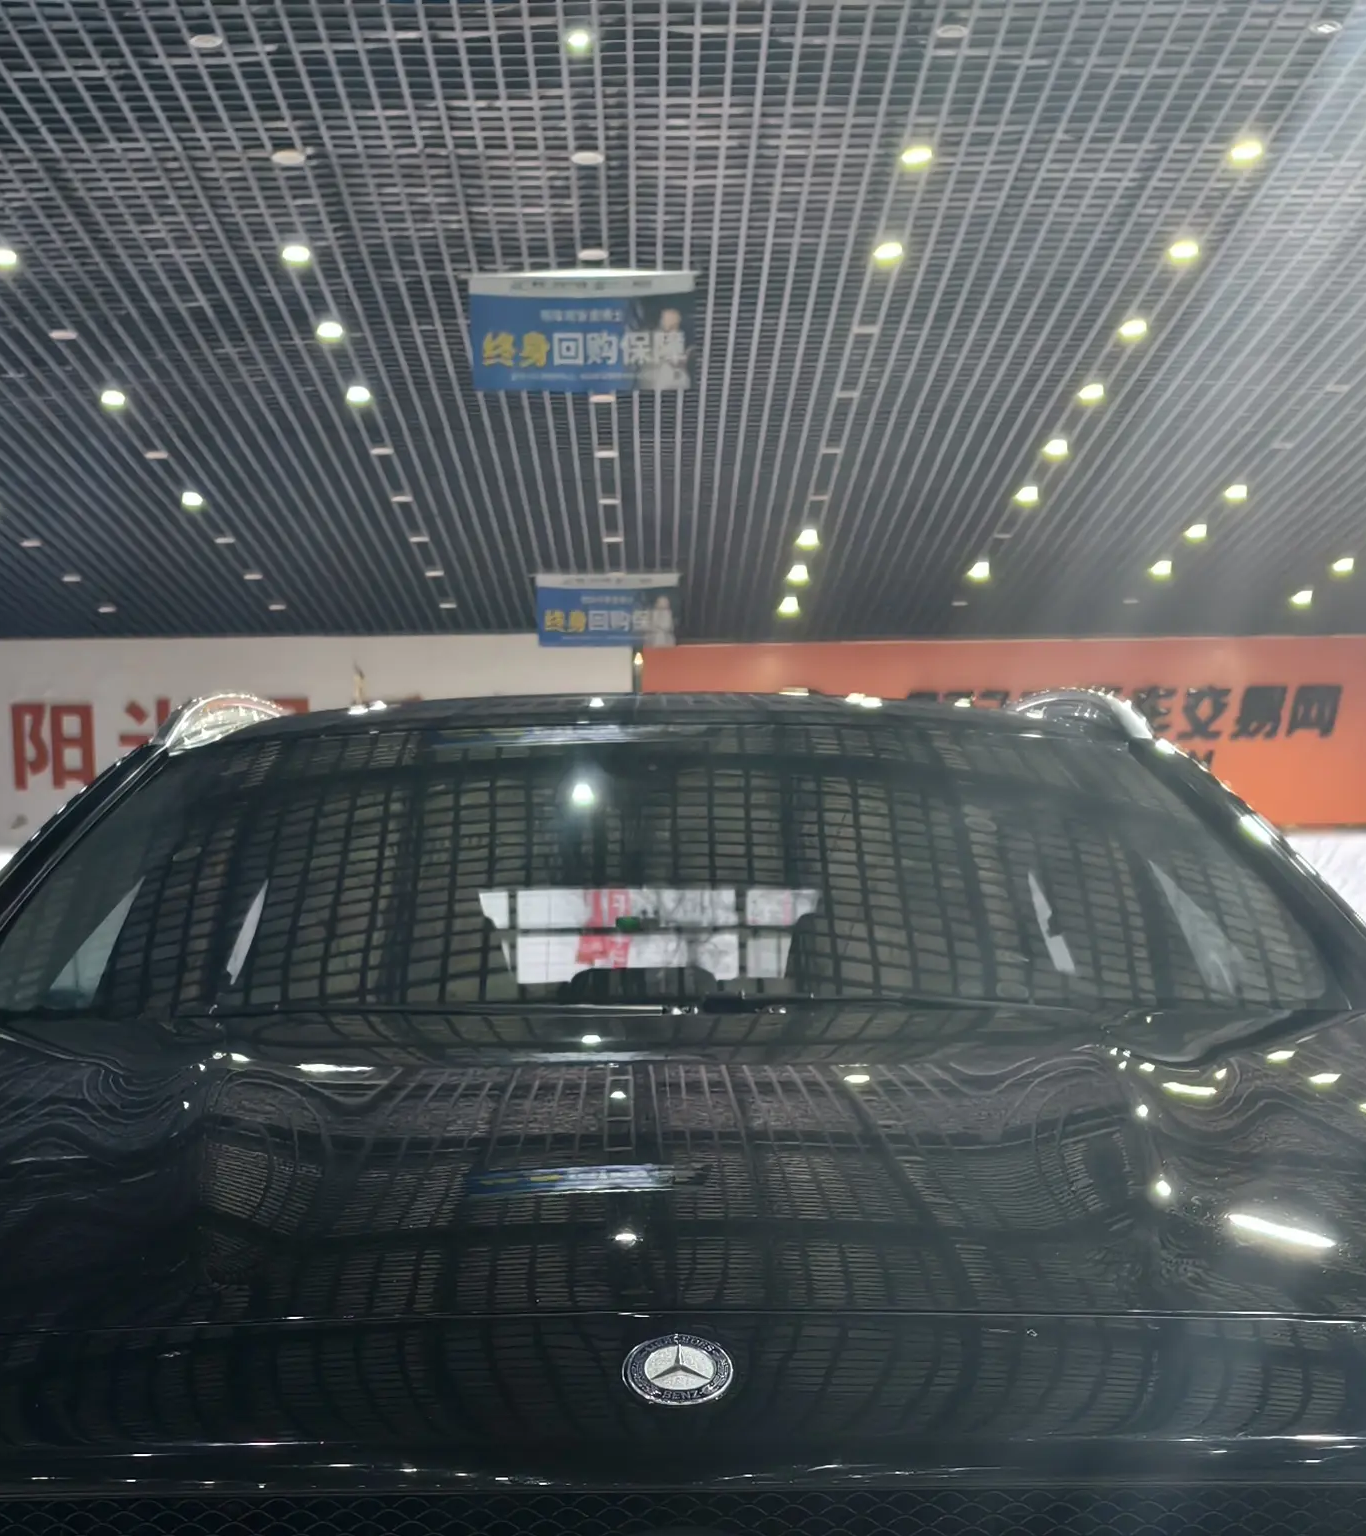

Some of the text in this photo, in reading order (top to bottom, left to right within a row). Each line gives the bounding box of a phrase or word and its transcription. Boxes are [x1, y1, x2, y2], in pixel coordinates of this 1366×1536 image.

[482, 330, 687, 368] 终身回购保障
[662, 1389, 702, 1401] BENZ
